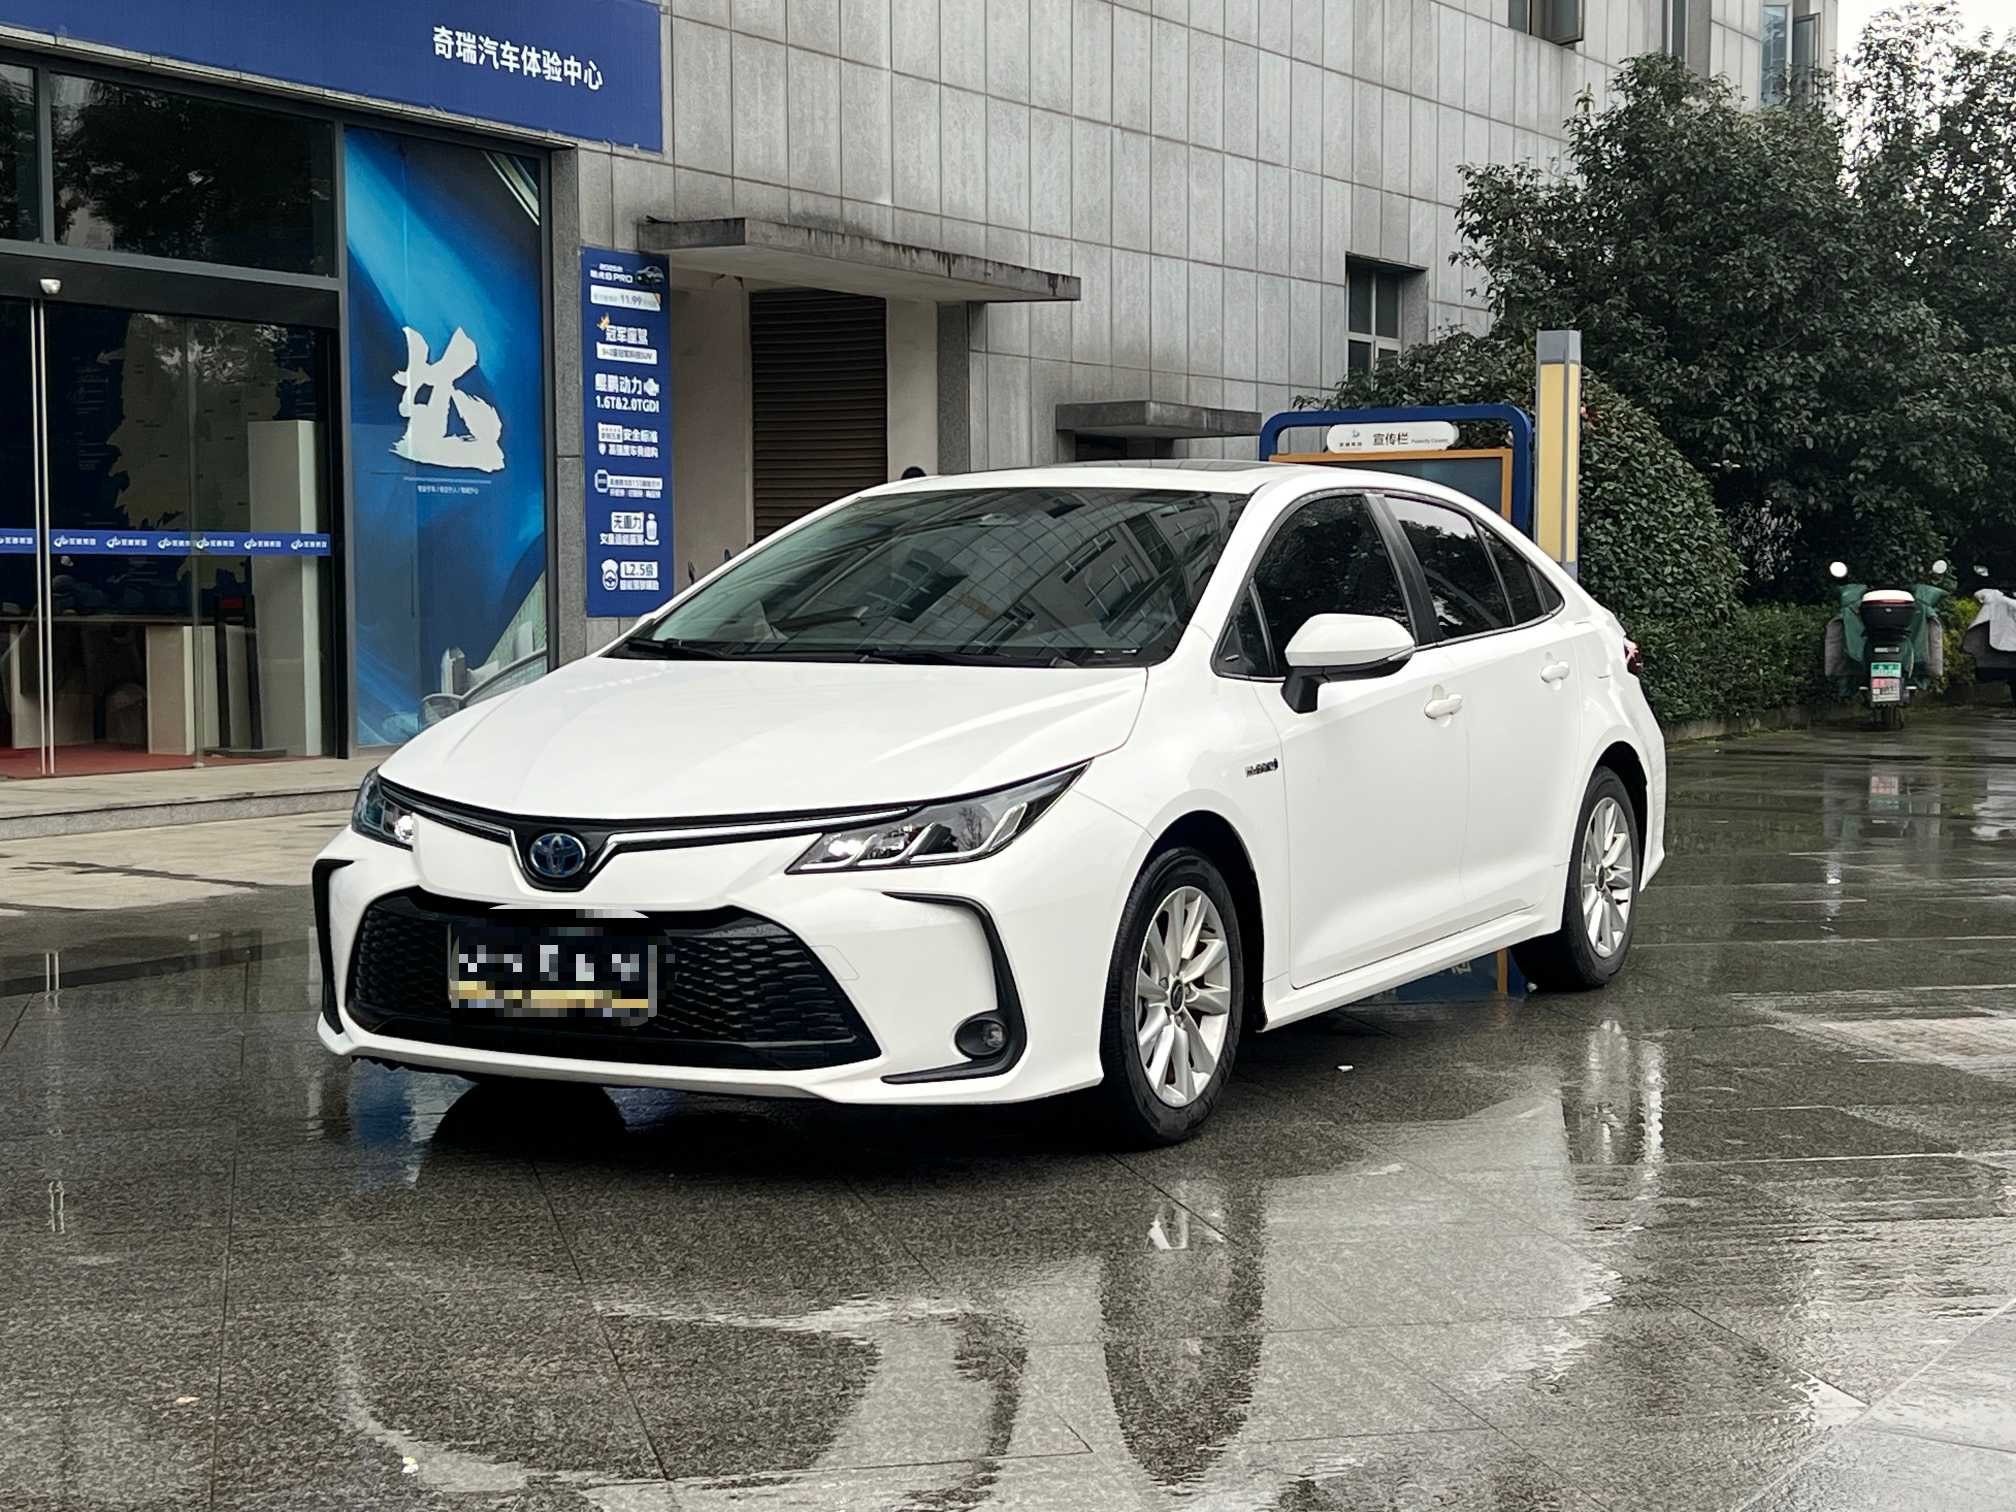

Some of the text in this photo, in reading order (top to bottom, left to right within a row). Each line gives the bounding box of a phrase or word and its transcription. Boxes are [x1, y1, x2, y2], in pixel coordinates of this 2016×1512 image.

[432, 25, 604, 91] 奇瑞汽车体验中心
[613, 273, 633, 284] PRO
[595, 395, 660, 413] 1.6T&2.0TGDI
[1373, 432, 1409, 446] 宣传栏
